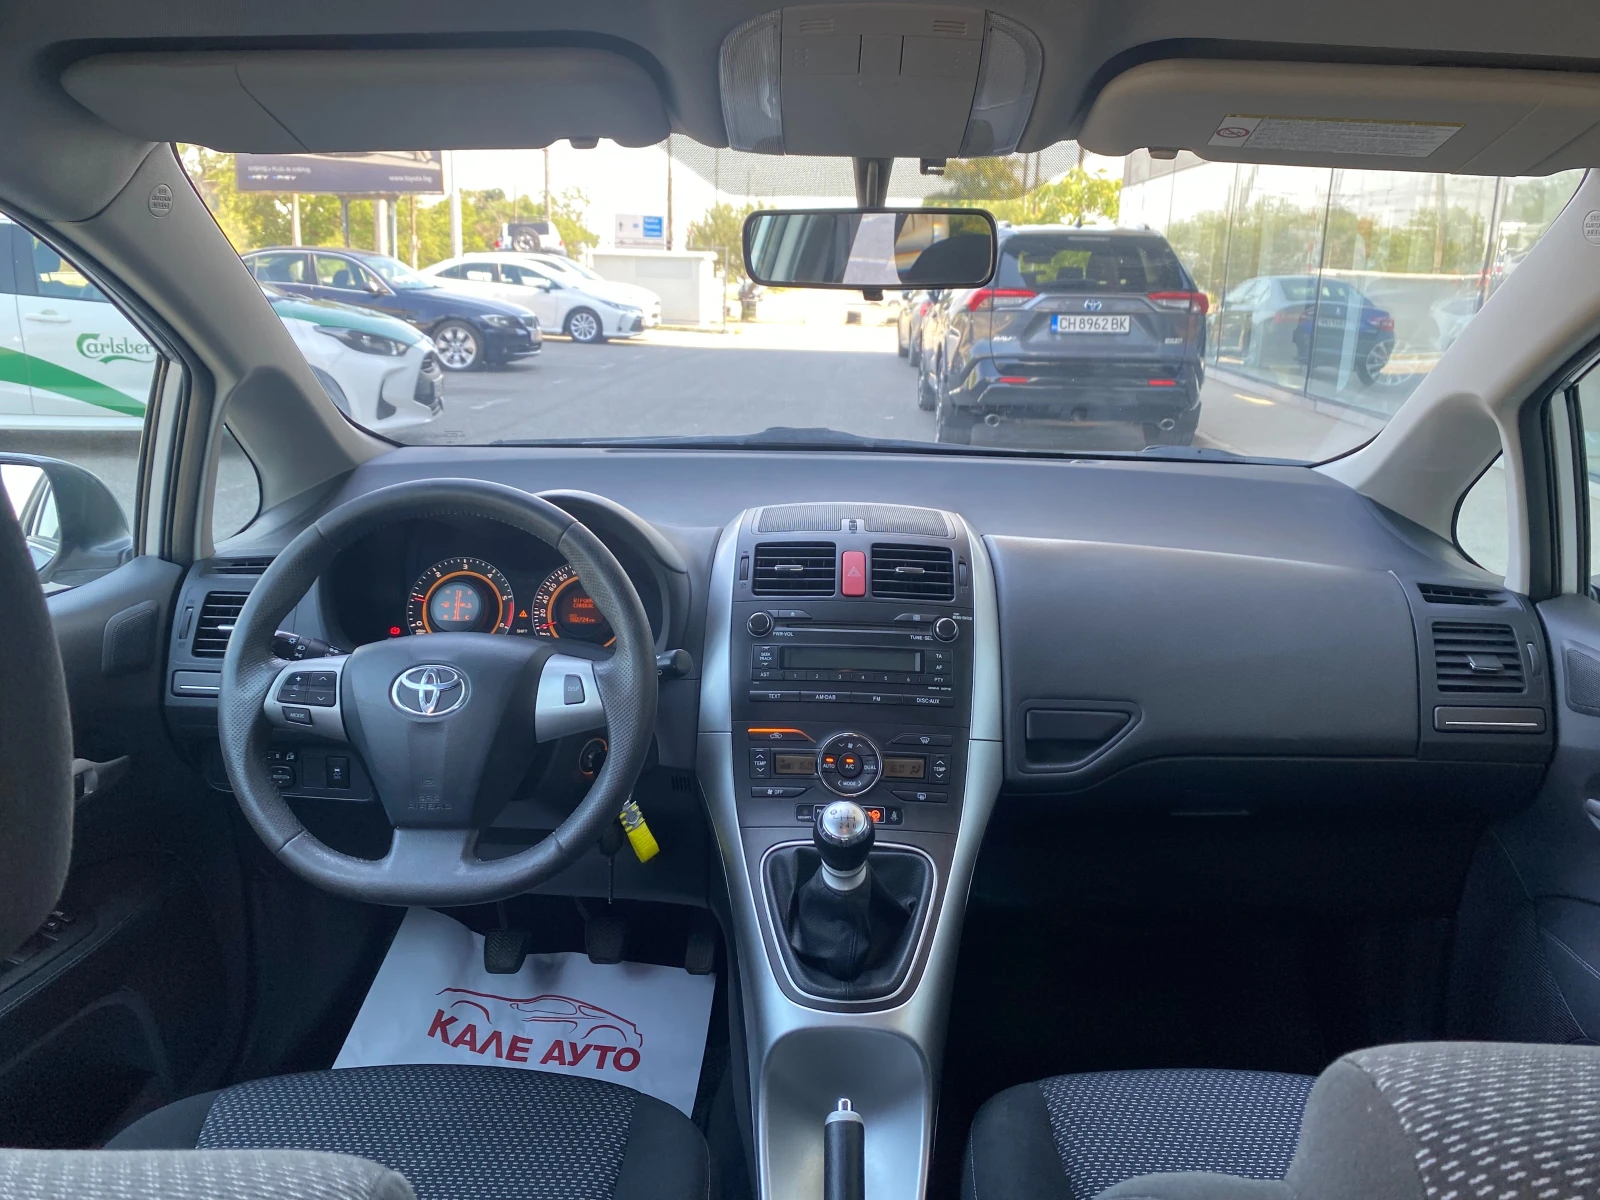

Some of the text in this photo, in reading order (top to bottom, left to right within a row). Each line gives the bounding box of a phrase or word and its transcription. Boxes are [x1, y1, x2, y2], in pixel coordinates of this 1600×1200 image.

[1079, 318, 1109, 331] 8962
[76, 333, 157, 358] Carlsber
[558, 573, 568, 582] 80
[548, 583, 557, 592] 60
[542, 595, 549, 605] 40
[540, 608, 546, 617] 20
[540, 1039, 641, 1072] АУТО
